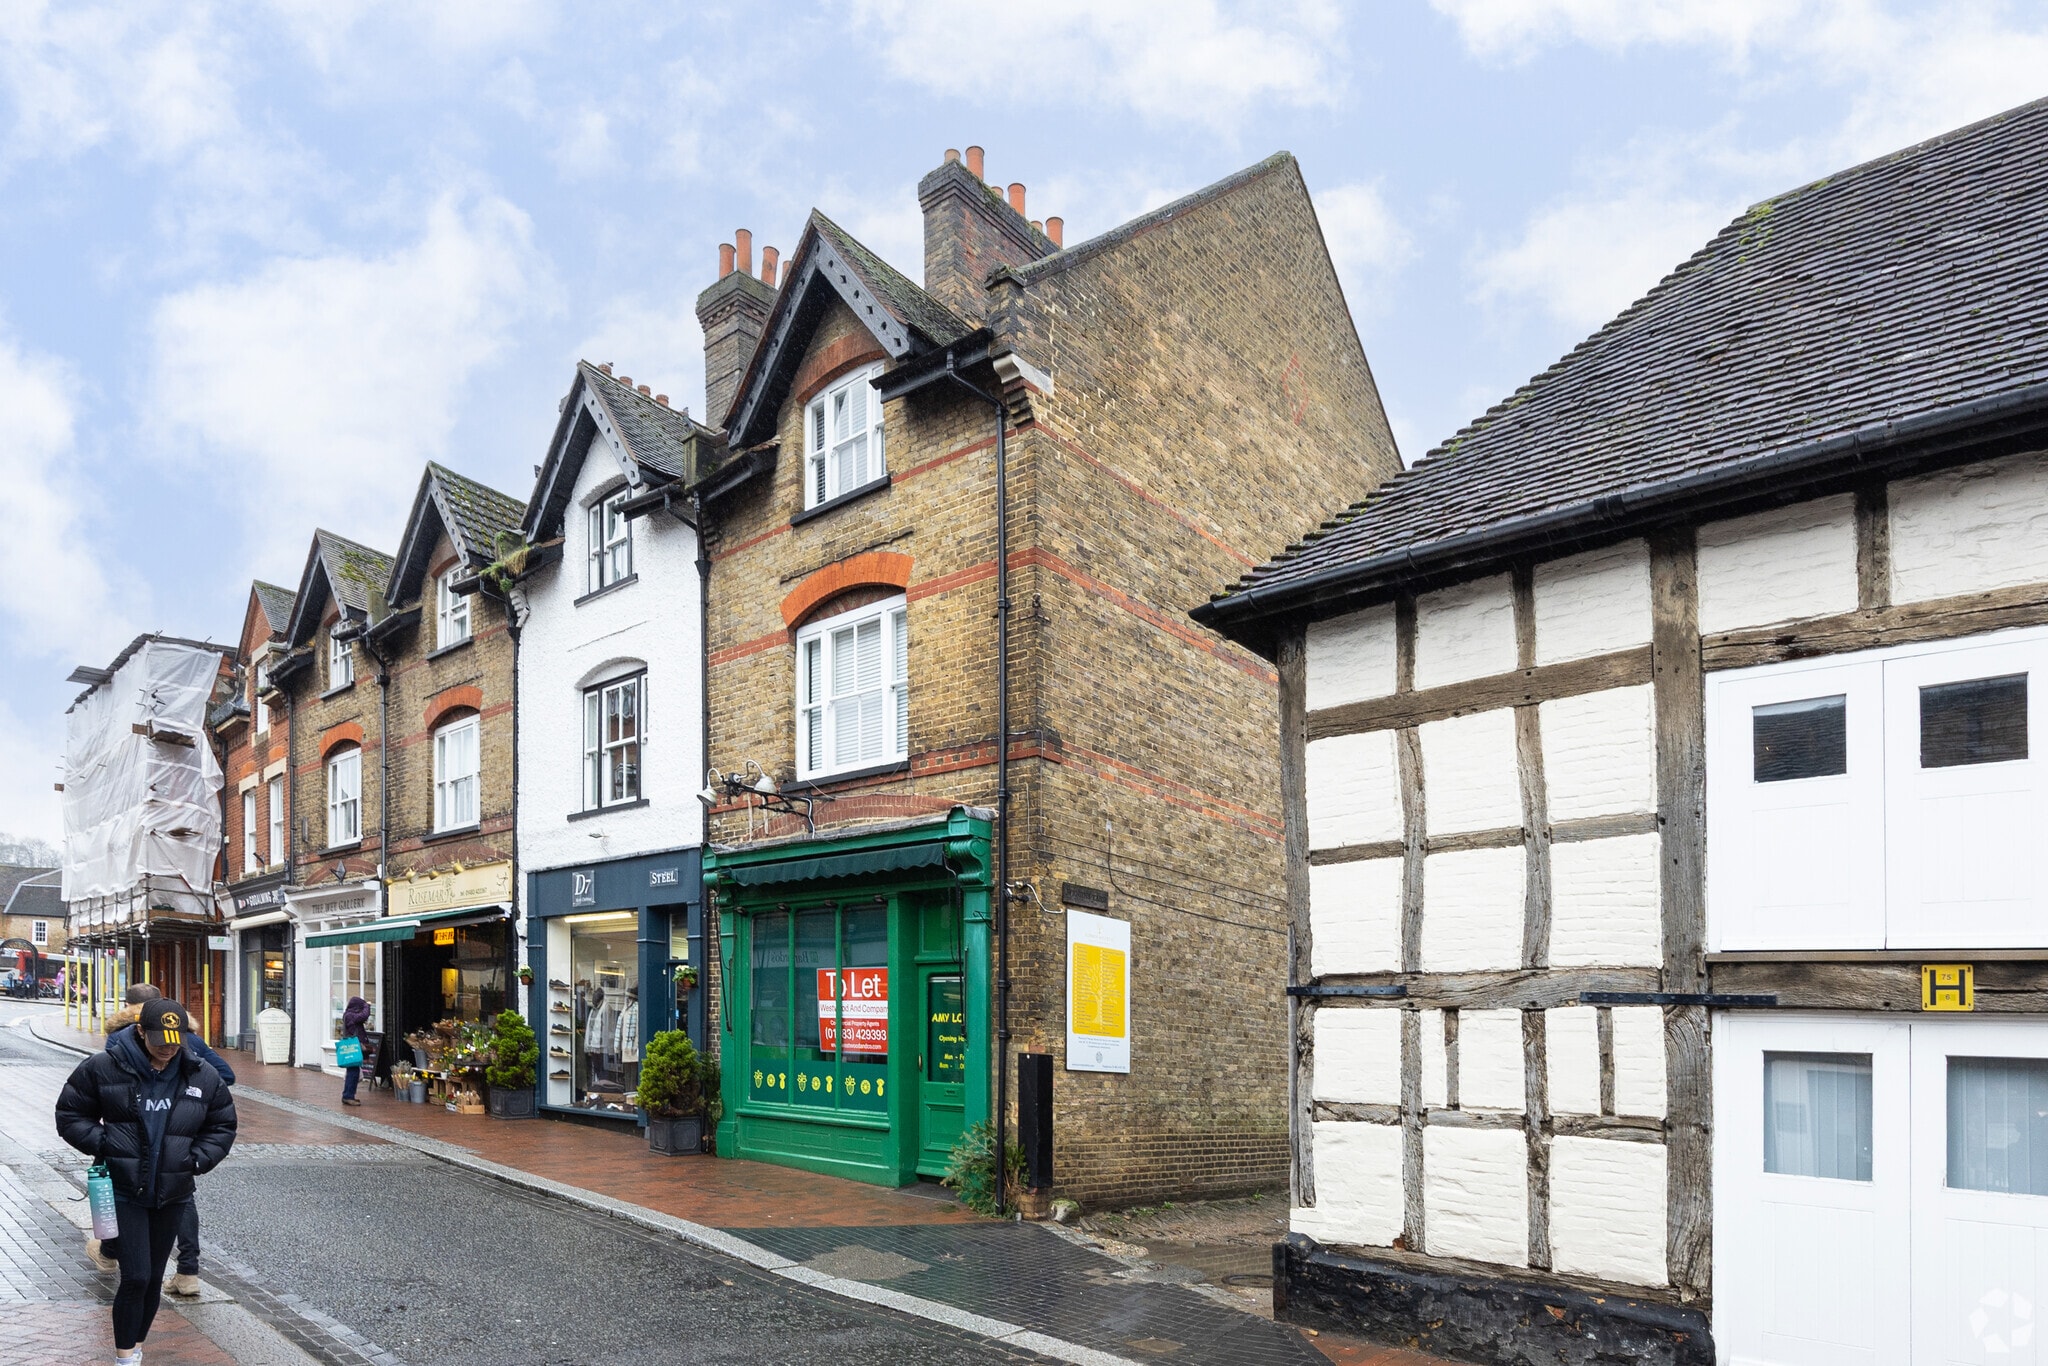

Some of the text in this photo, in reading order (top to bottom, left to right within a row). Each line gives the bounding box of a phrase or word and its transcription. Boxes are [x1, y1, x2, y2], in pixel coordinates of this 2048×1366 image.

[651, 870, 676, 884] STEEL
[574, 874, 591, 895] D7
[312, 904, 324, 914] THE
[338, 897, 366, 911] GALLERY
[1941, 973, 1952, 981] 75
[851, 971, 881, 998] Let
[1929, 969, 1966, 1006] H
[820, 1004, 888, 1015] Westod And Compan
[931, 1013, 950, 1023] AMY
[825, 1026, 887, 1041] (0183) 429393
[938, 1034, 958, 1043] Opening
